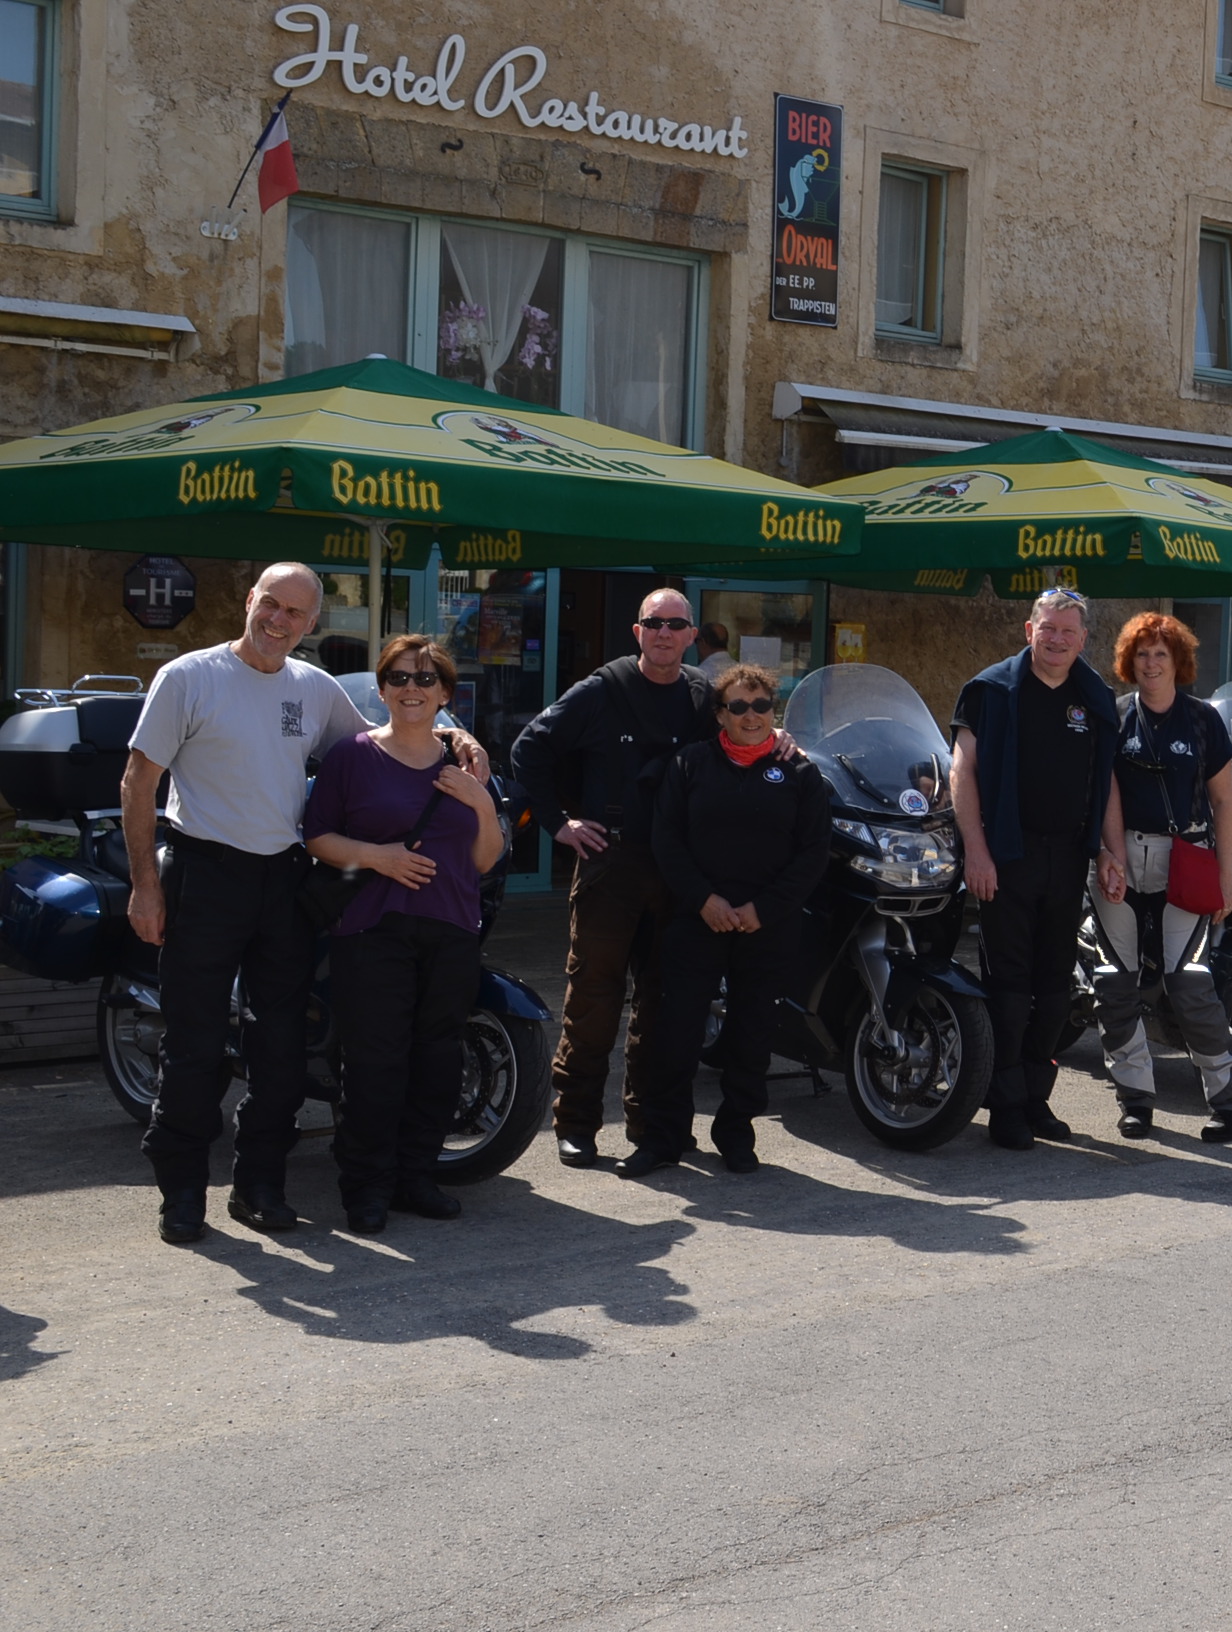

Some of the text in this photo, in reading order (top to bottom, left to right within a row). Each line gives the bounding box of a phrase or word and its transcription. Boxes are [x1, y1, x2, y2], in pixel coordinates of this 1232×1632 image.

[273, 4, 749, 158] Hotel Restaurant
[787, 110, 832, 148] BIER
[781, 224, 838, 270] ORVAL
[776, 276, 788, 286] DER
[788, 297, 836, 315] TRAPPISTEN
[459, 437, 666, 478] Battin
[178, 458, 258, 506] Battin
[331, 459, 443, 513] Battin
[760, 501, 842, 544] Battin
[1017, 524, 1106, 559] Battin
[1158, 525, 1221, 563] Battin
[149, 577, 172, 606] H
